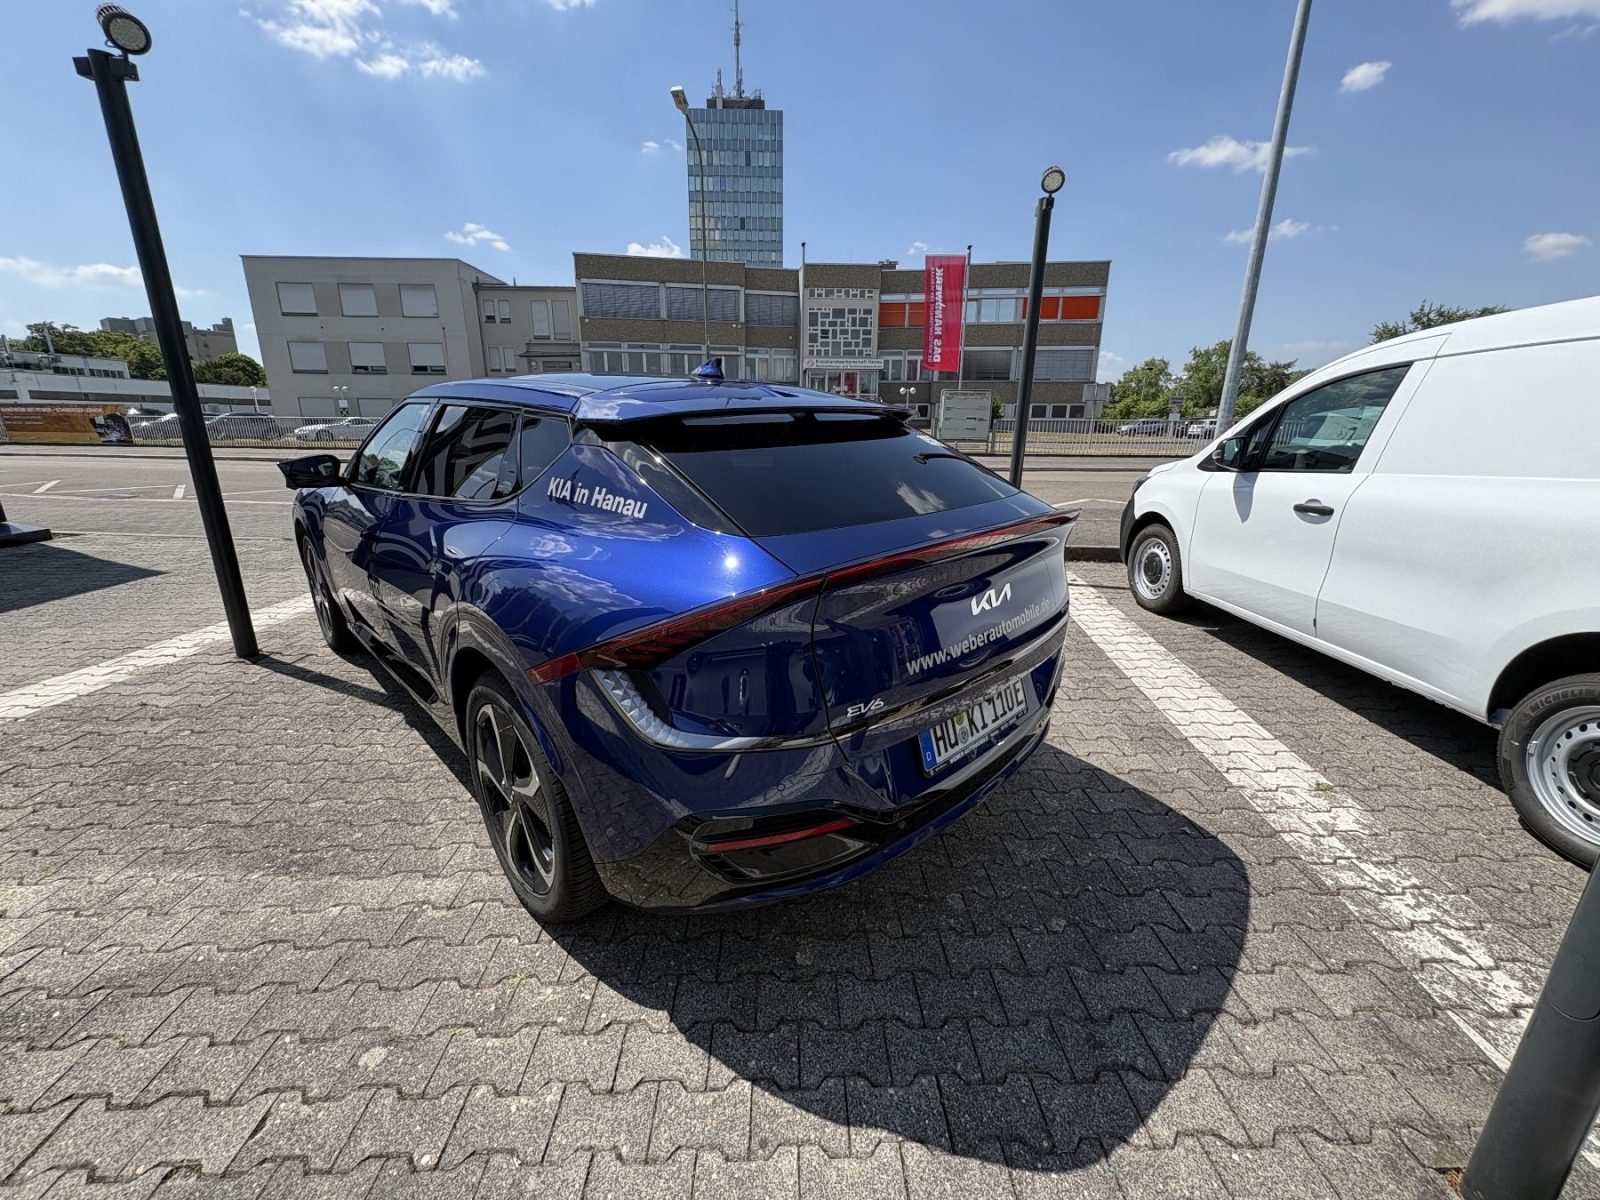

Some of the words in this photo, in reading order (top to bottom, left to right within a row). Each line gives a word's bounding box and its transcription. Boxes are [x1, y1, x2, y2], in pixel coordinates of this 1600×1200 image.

[547, 477, 572, 501] KIA
[574, 482, 590, 505] in
[590, 486, 648, 519] Hanau
[906, 598, 1050, 676] www.weberautomobile.de
[846, 697, 885, 718] EV6
[932, 717, 959, 757] HU
[966, 704, 989, 737] KI
[988, 680, 1024, 723] 110E
[1528, 688, 1595, 714] MICHELIN
